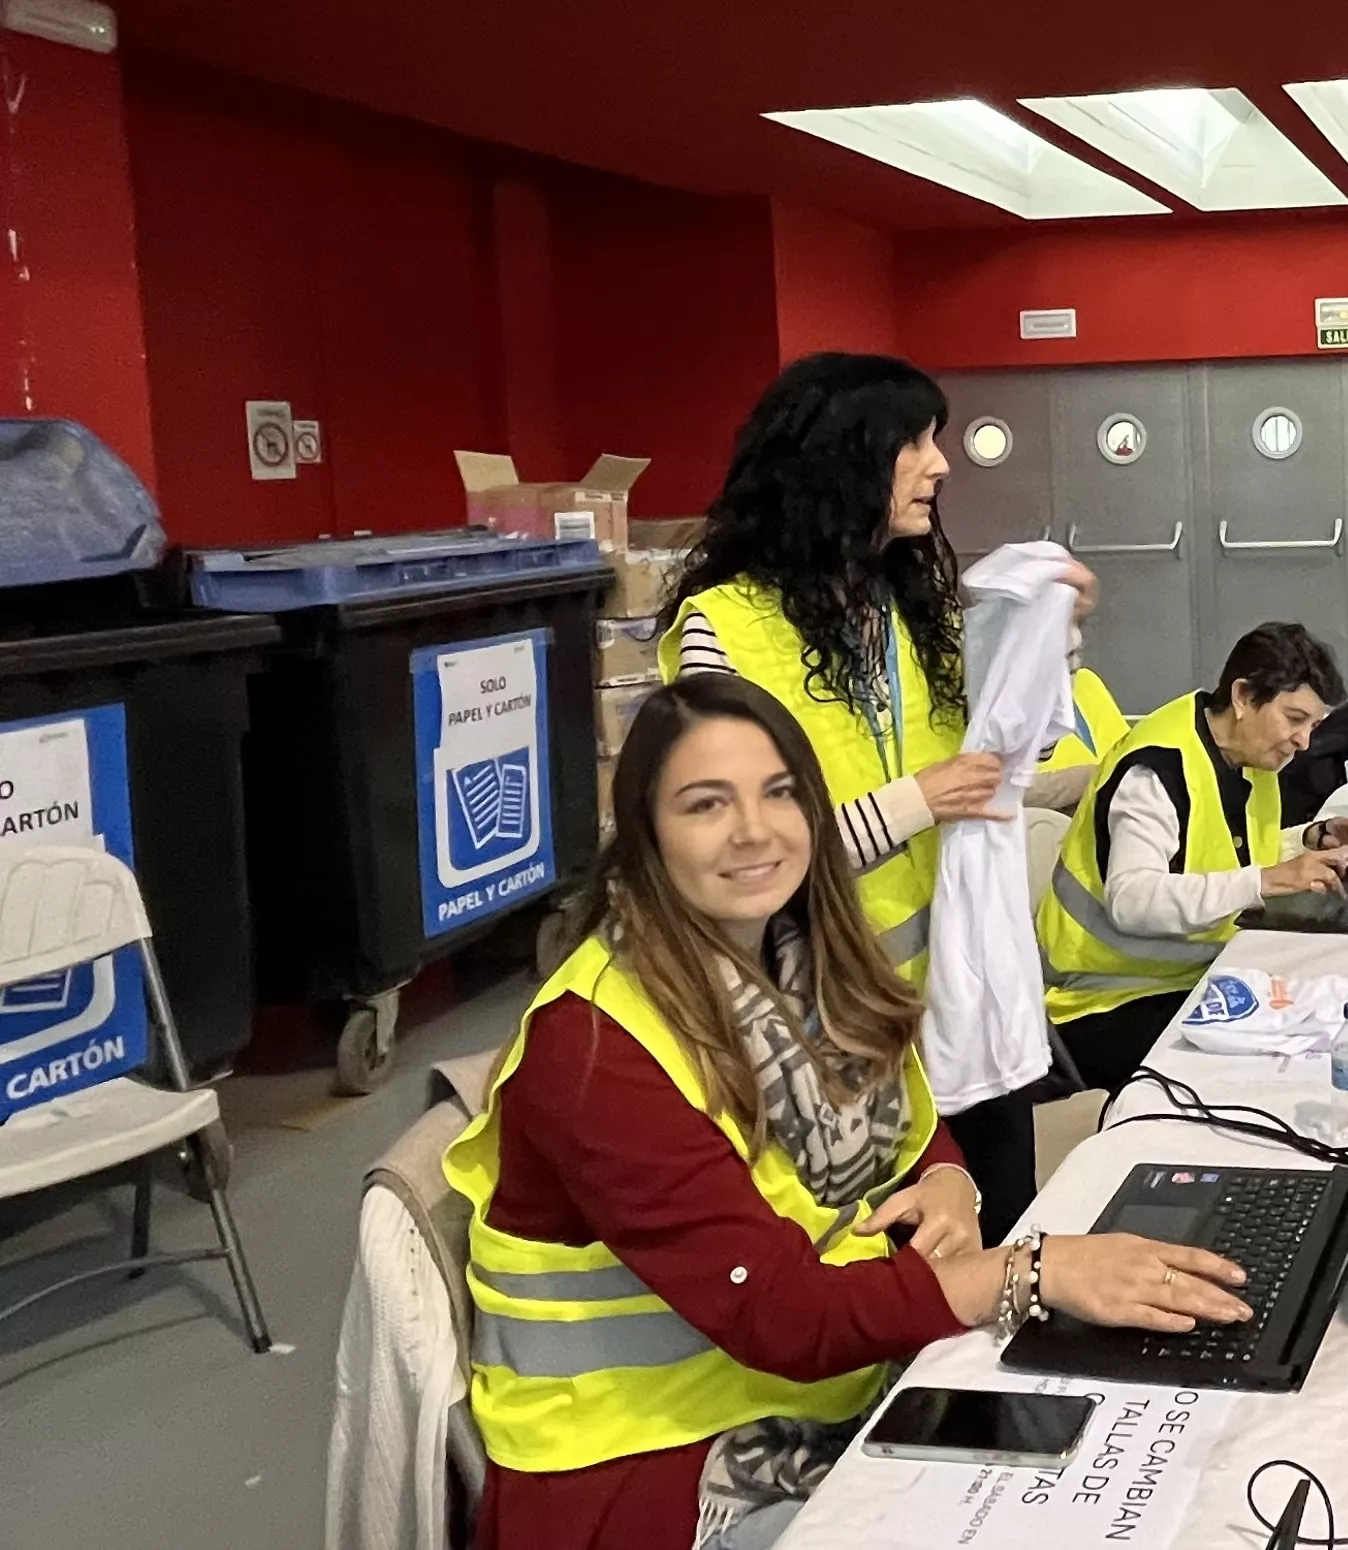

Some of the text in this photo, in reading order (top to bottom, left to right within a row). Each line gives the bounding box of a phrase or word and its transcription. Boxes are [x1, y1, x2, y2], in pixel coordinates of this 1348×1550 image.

[479, 676, 507, 694] SOLO
[448, 692, 532, 726] PAPEL Y CARTÓN
[0, 800, 79, 836] ARTÓN
[438, 861, 545, 921] PAPEL Y CARTÓN
[6, 1036, 125, 1099] CARTÓN
[1092, 1400, 1150, 1469] TALLAS
[1158, 1410, 1190, 1434] SE
[1072, 1475, 1110, 1505] DE
[1105, 1440, 1176, 1540] CAMBIAN
